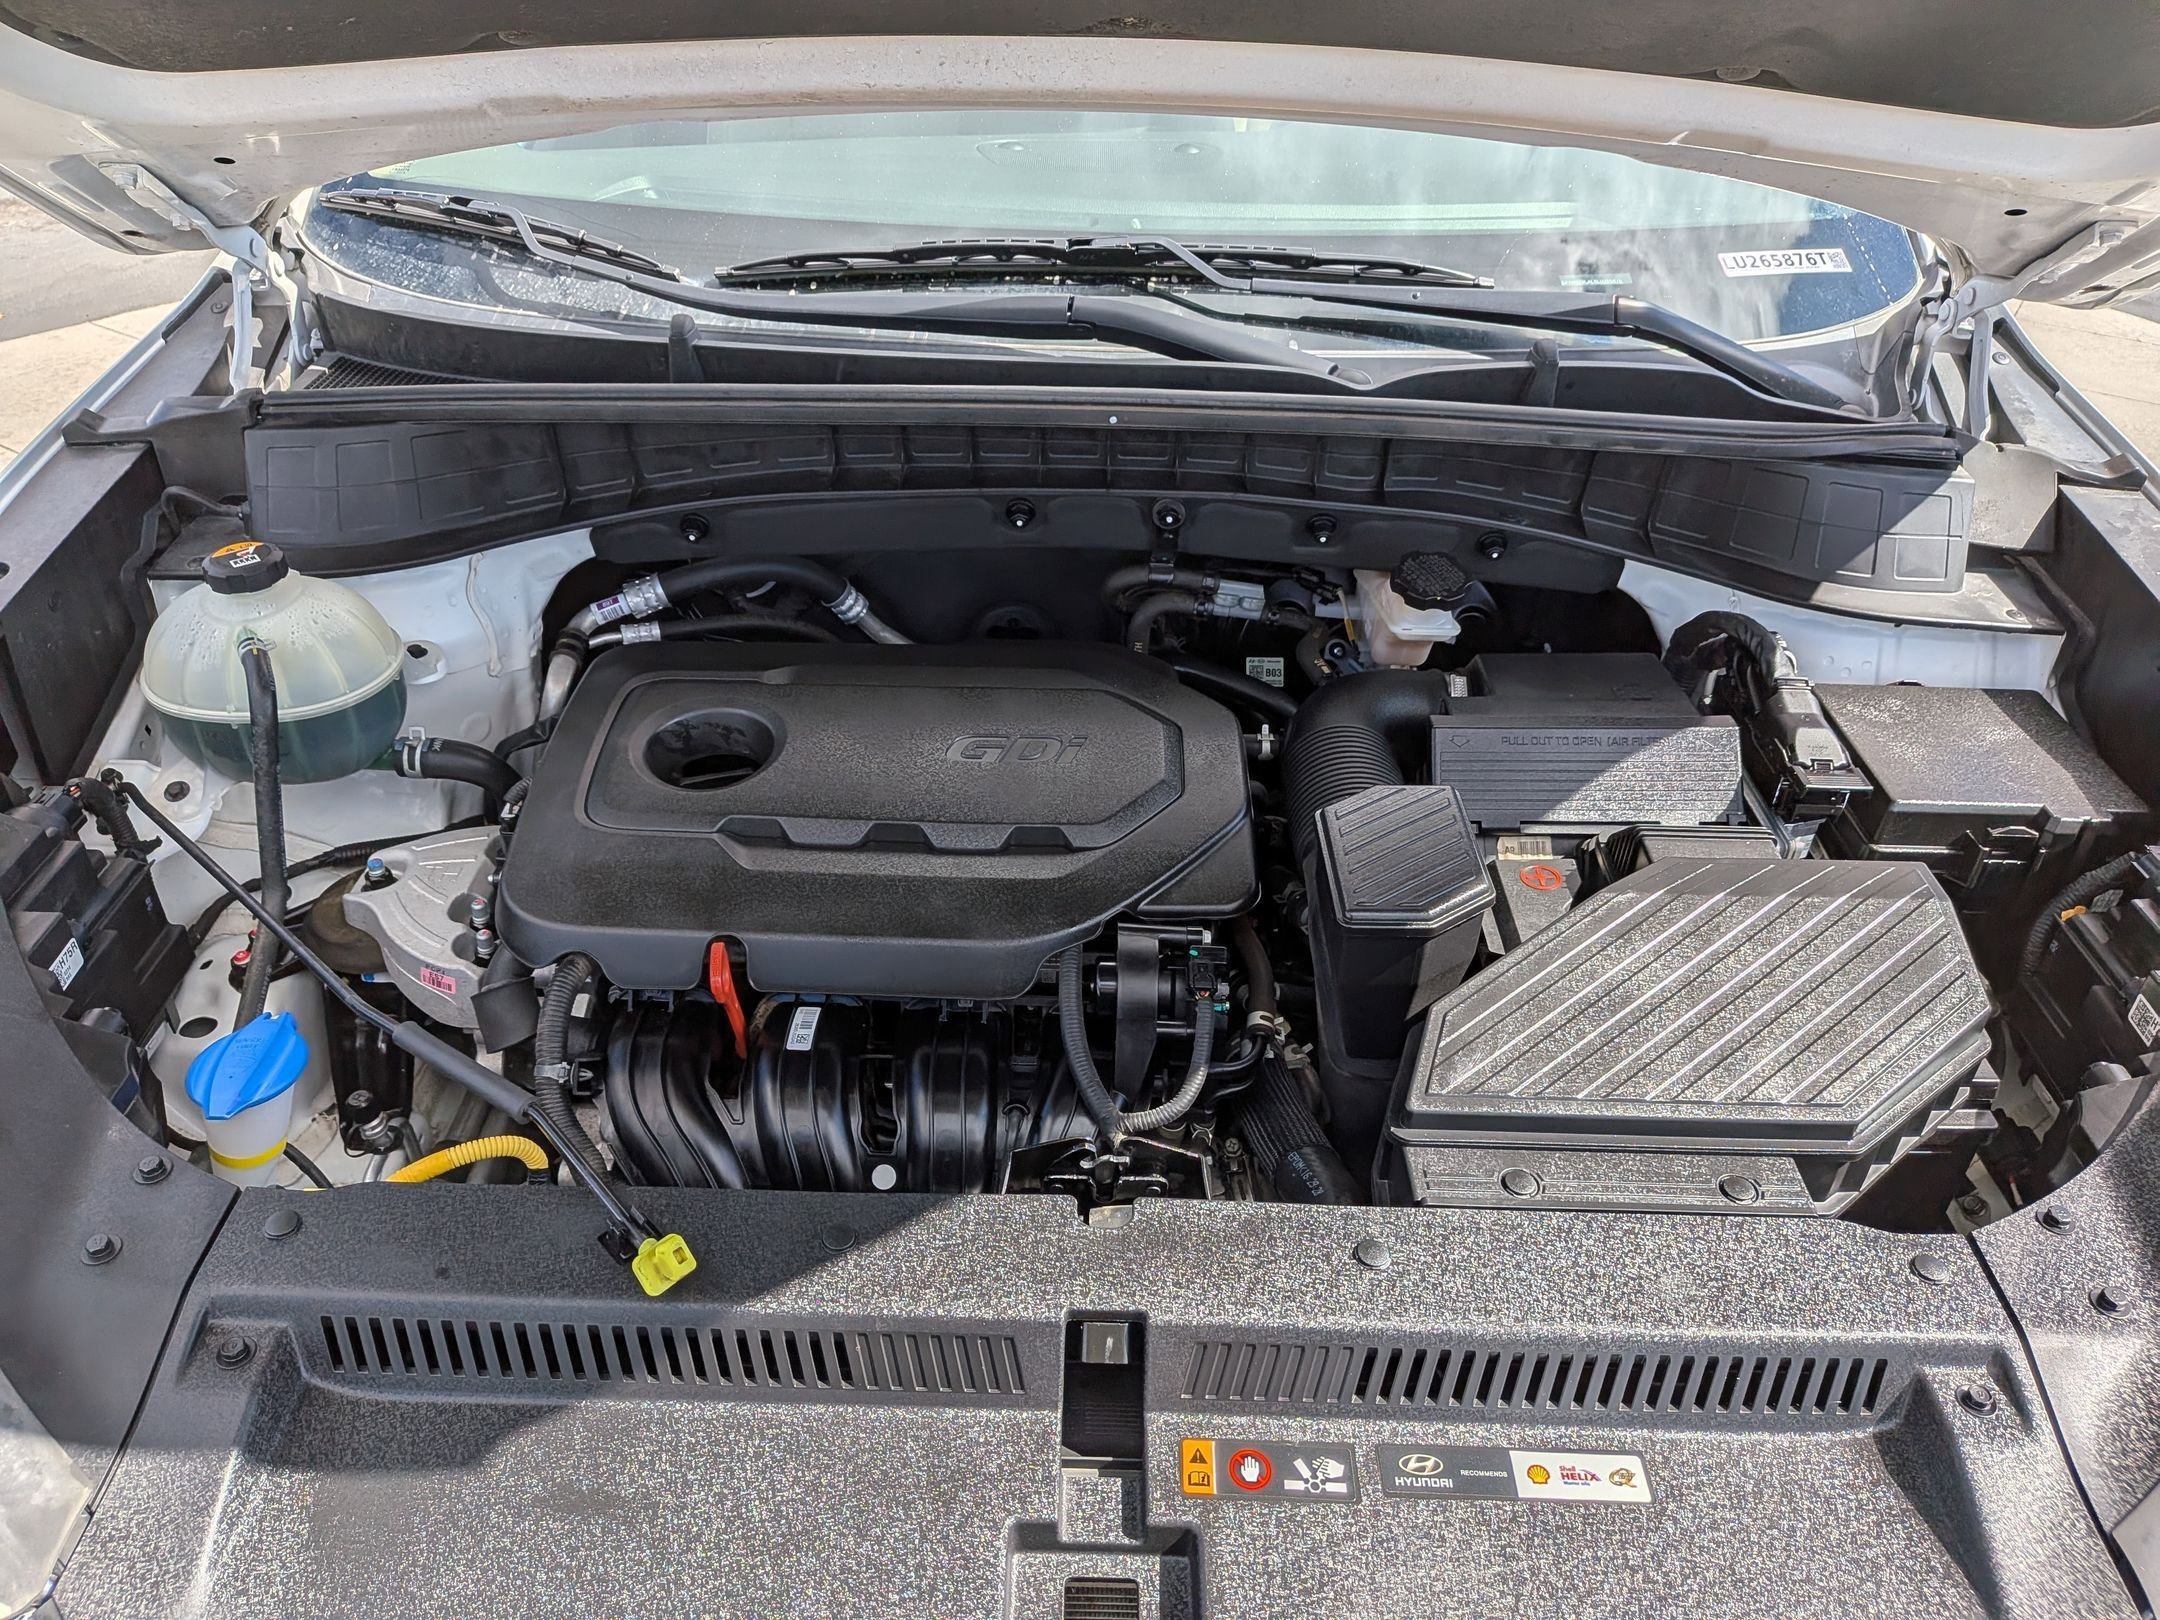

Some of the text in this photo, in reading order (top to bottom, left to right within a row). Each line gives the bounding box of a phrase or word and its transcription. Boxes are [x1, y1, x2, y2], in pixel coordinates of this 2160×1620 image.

[1722, 252, 1827, 270] LU265876T
[1265, 668, 1282, 677] B03
[1501, 736, 1528, 746] PULL
[1531, 736, 1553, 746] OUT
[1555, 736, 1569, 746] TO
[1573, 736, 1602, 746] OPEN
[1607, 736, 1629, 747] (AIR
[945, 735, 1088, 763] GDi
[58, 941, 78, 969] H75R
[1460, 1469, 1508, 1478] RECOMMENDS
[1560, 1472, 1601, 1482] HELIX
[1395, 1476, 1454, 1489] HYUNDAI
